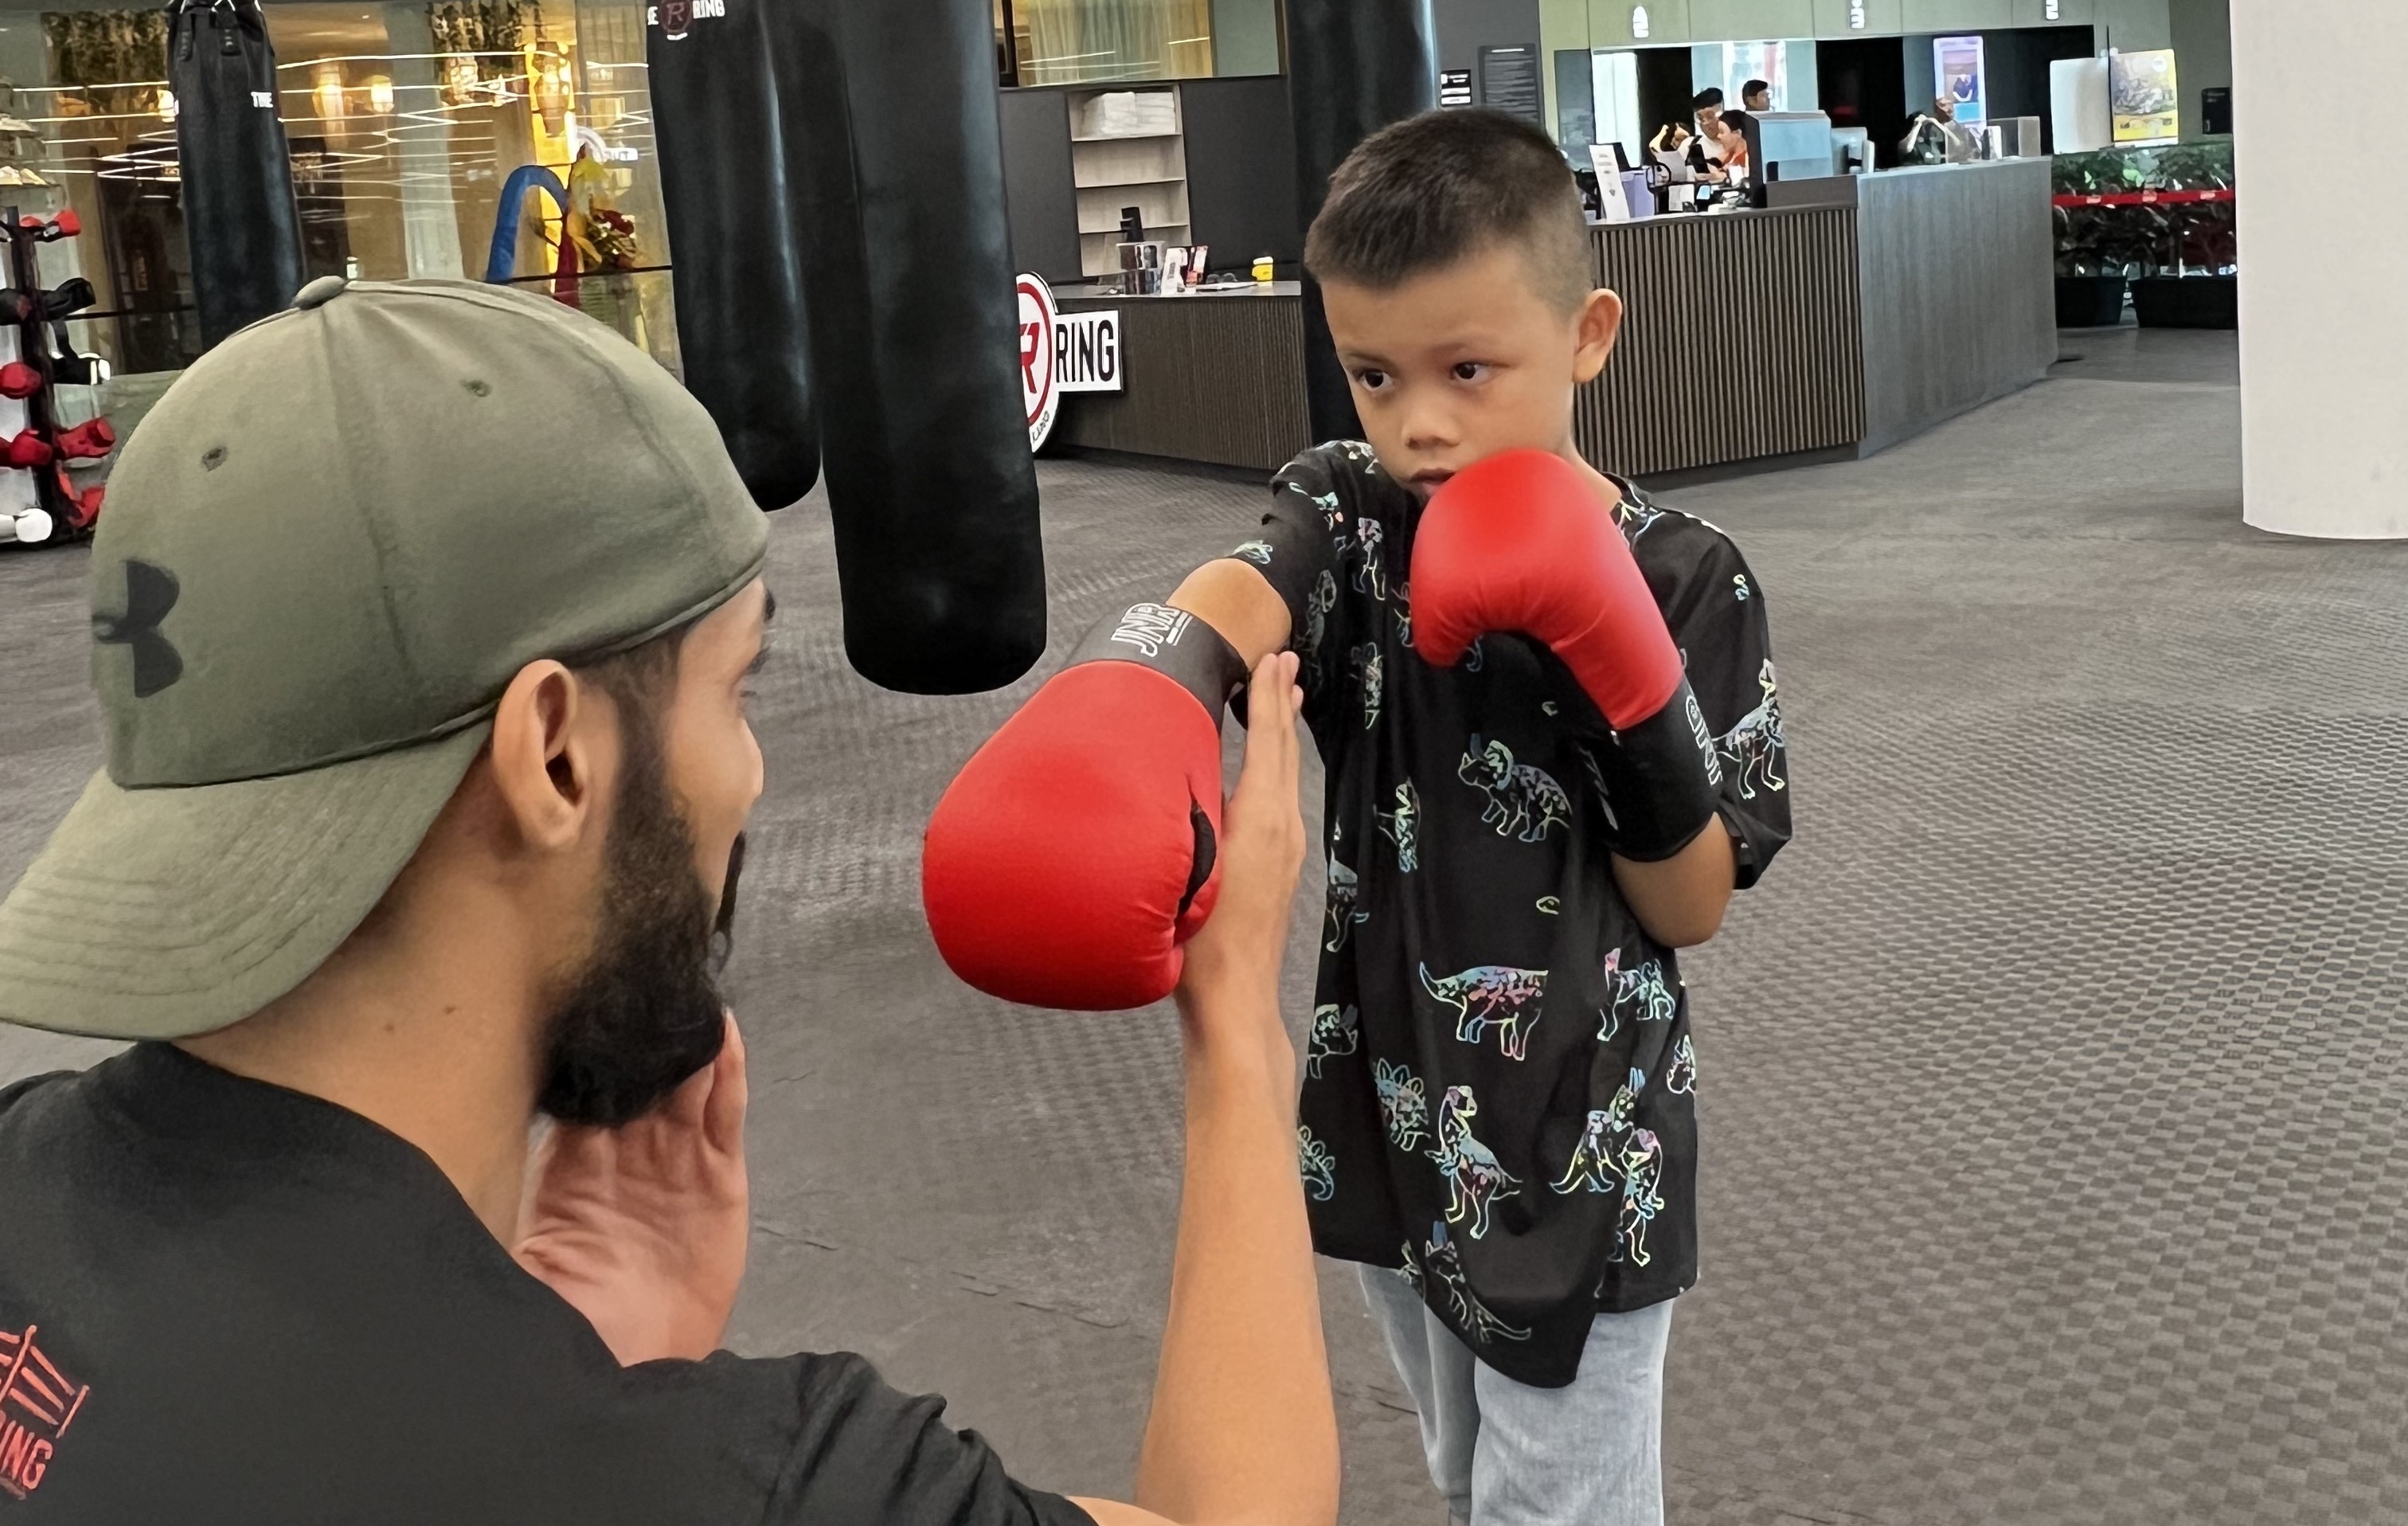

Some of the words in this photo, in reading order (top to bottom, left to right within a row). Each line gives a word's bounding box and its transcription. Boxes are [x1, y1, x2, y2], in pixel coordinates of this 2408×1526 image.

[693, 0, 725, 19] RING
[1056, 320, 1115, 382] RING
[0, 1410, 53, 1489] ING
